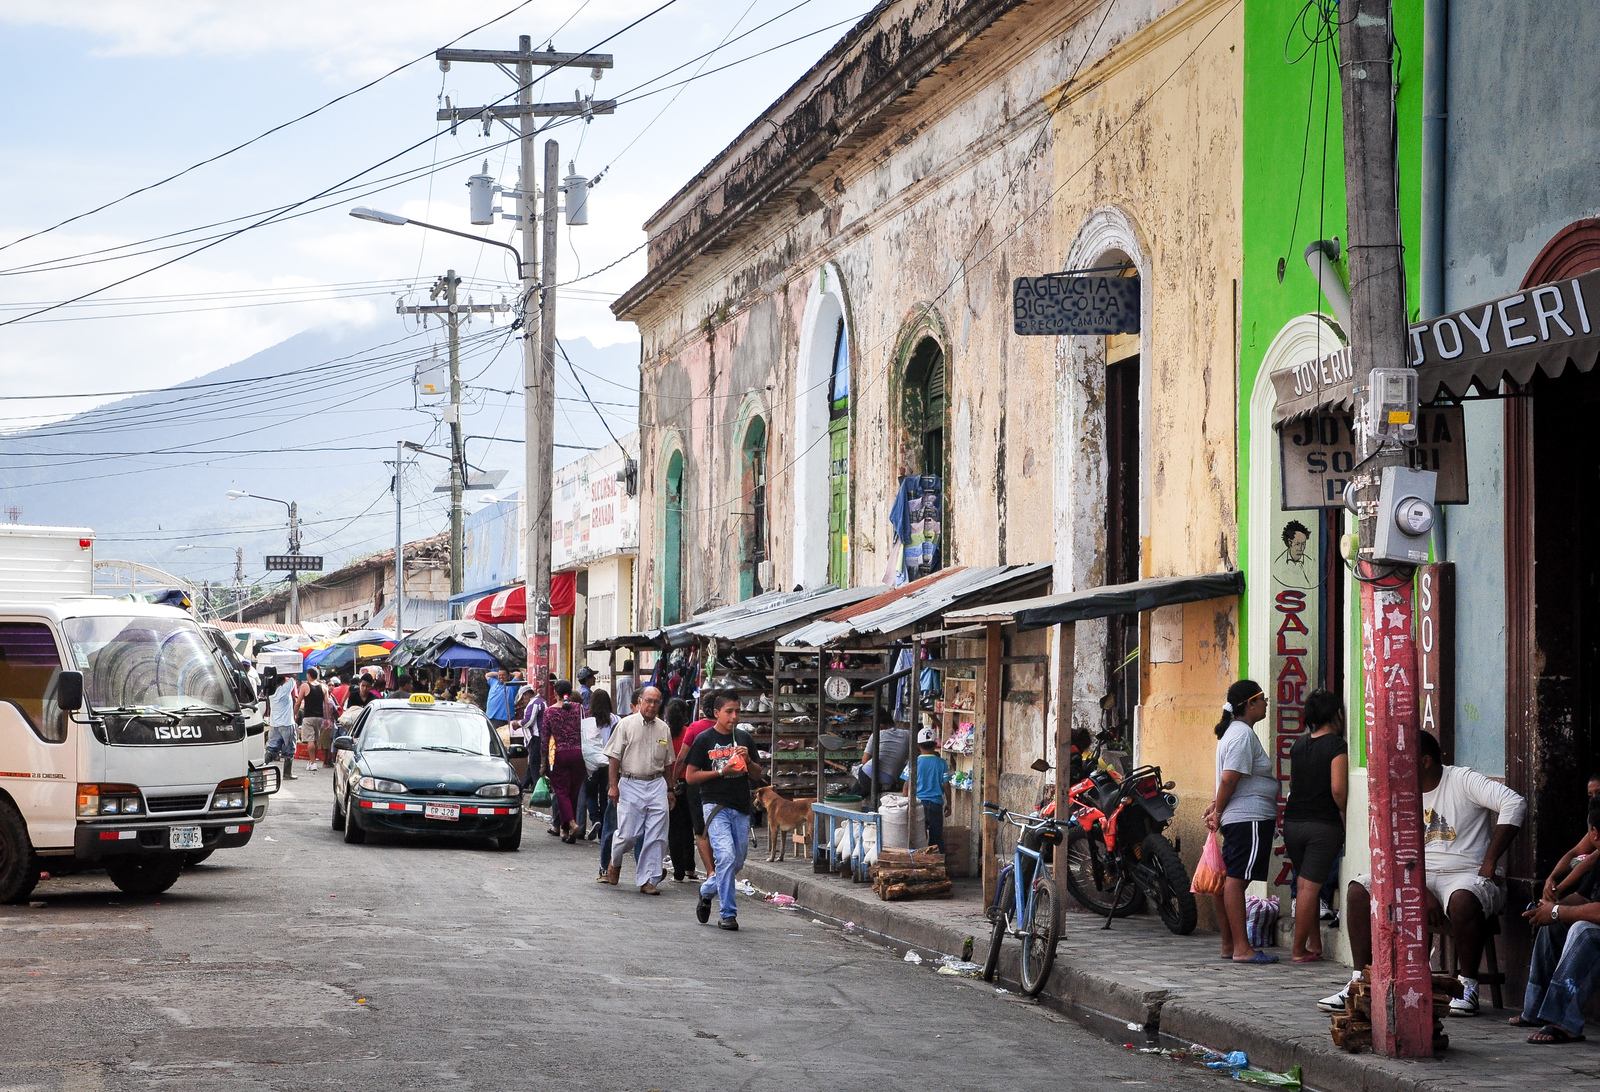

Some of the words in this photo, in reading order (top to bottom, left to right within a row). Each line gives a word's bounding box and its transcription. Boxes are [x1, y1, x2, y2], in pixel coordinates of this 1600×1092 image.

[1014, 277, 1111, 298] AGENCIA
[1021, 318, 1064, 330] PRECIO
[591, 503, 615, 529] GRANADA
[1275, 589, 1309, 682] SALA
[413, 695, 432, 703] TAXI
[1277, 681, 1307, 705] DE
[154, 725, 202, 740] ISUZU
[172, 833, 181, 843] GR
[183, 832, 199, 843] 5045
